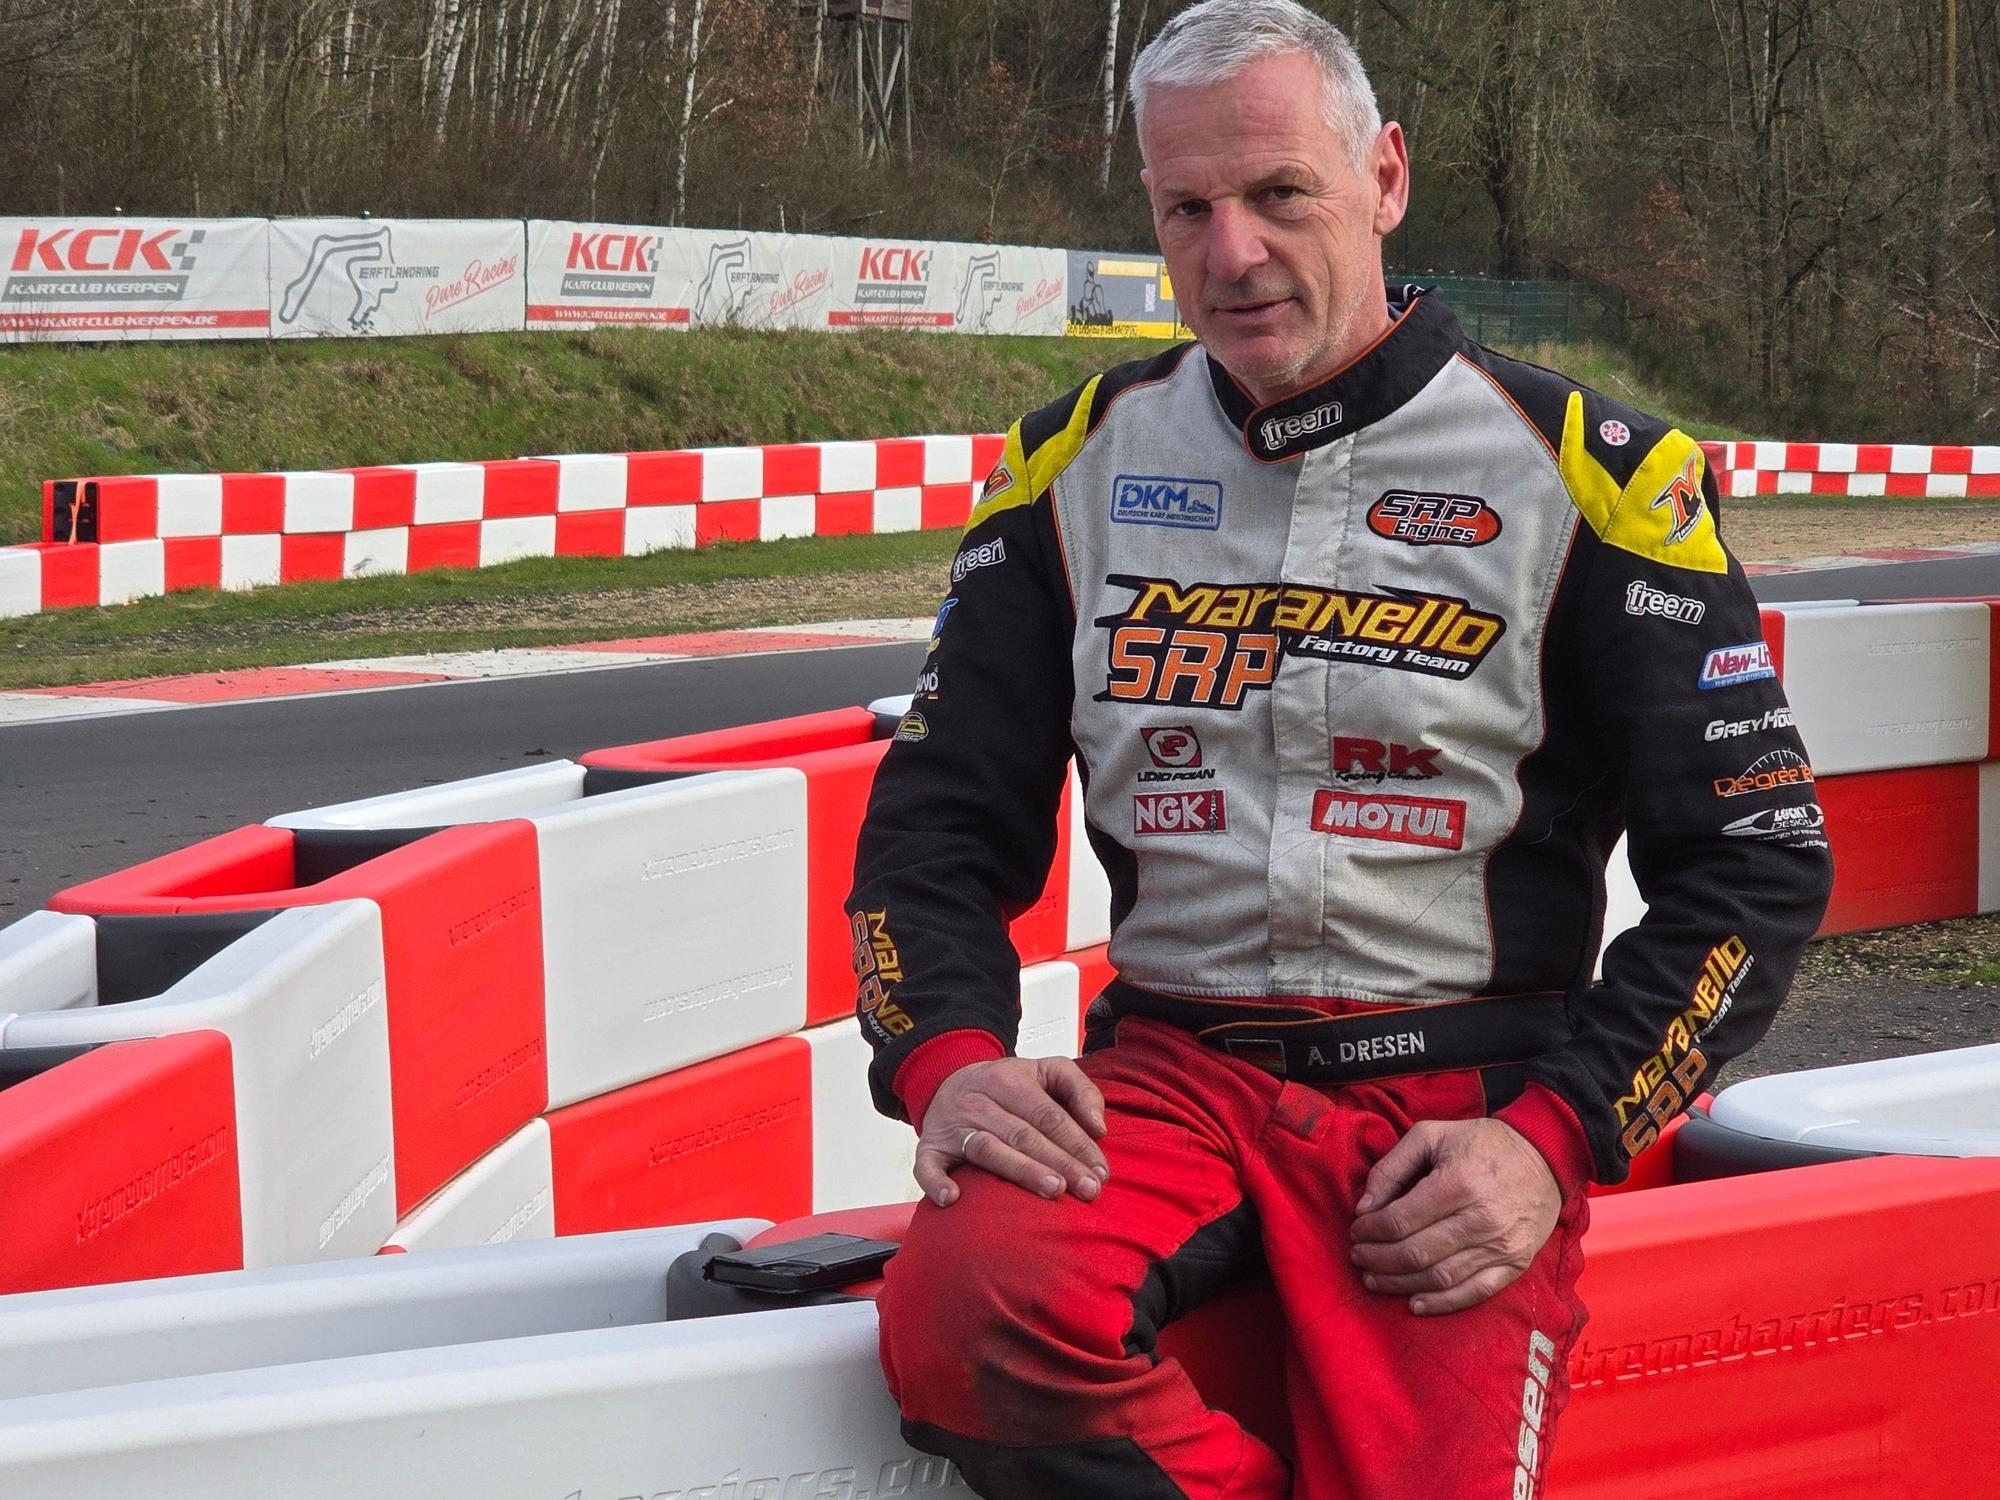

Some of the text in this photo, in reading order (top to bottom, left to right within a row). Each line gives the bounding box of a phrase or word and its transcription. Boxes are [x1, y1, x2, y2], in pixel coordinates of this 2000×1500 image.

[10, 229, 182, 271] KCK
[566, 232, 653, 272] KCK
[859, 247, 926, 281] KCK
[105, 282, 179, 294] KERPEN
[359, 266, 439, 279] ERFTLANDRING
[425, 255, 517, 320] Pure Racing
[616, 281, 650, 292] KERPEN
[1263, 403, 1341, 444] freem
[1120, 483, 1189, 512] DKM
[1377, 494, 1482, 522] SRP
[1392, 519, 1477, 543] Engines
[1627, 582, 1704, 623] freem
[1109, 627, 1280, 706] SRP
[1299, 634, 1471, 673] Factory Team
[1332, 736, 1443, 776] RK
[1135, 794, 1206, 831] NGK
[1322, 800, 1453, 839] MOTUL
[1771, 818, 1813, 830] DESIGN
[1774, 806, 1808, 822] LUCKY
[1694, 954, 1756, 1044] Factory Team
[1307, 1030, 1426, 1066] A. DRESEN
[1568, 1278, 2000, 1391] tremebarriers.co
